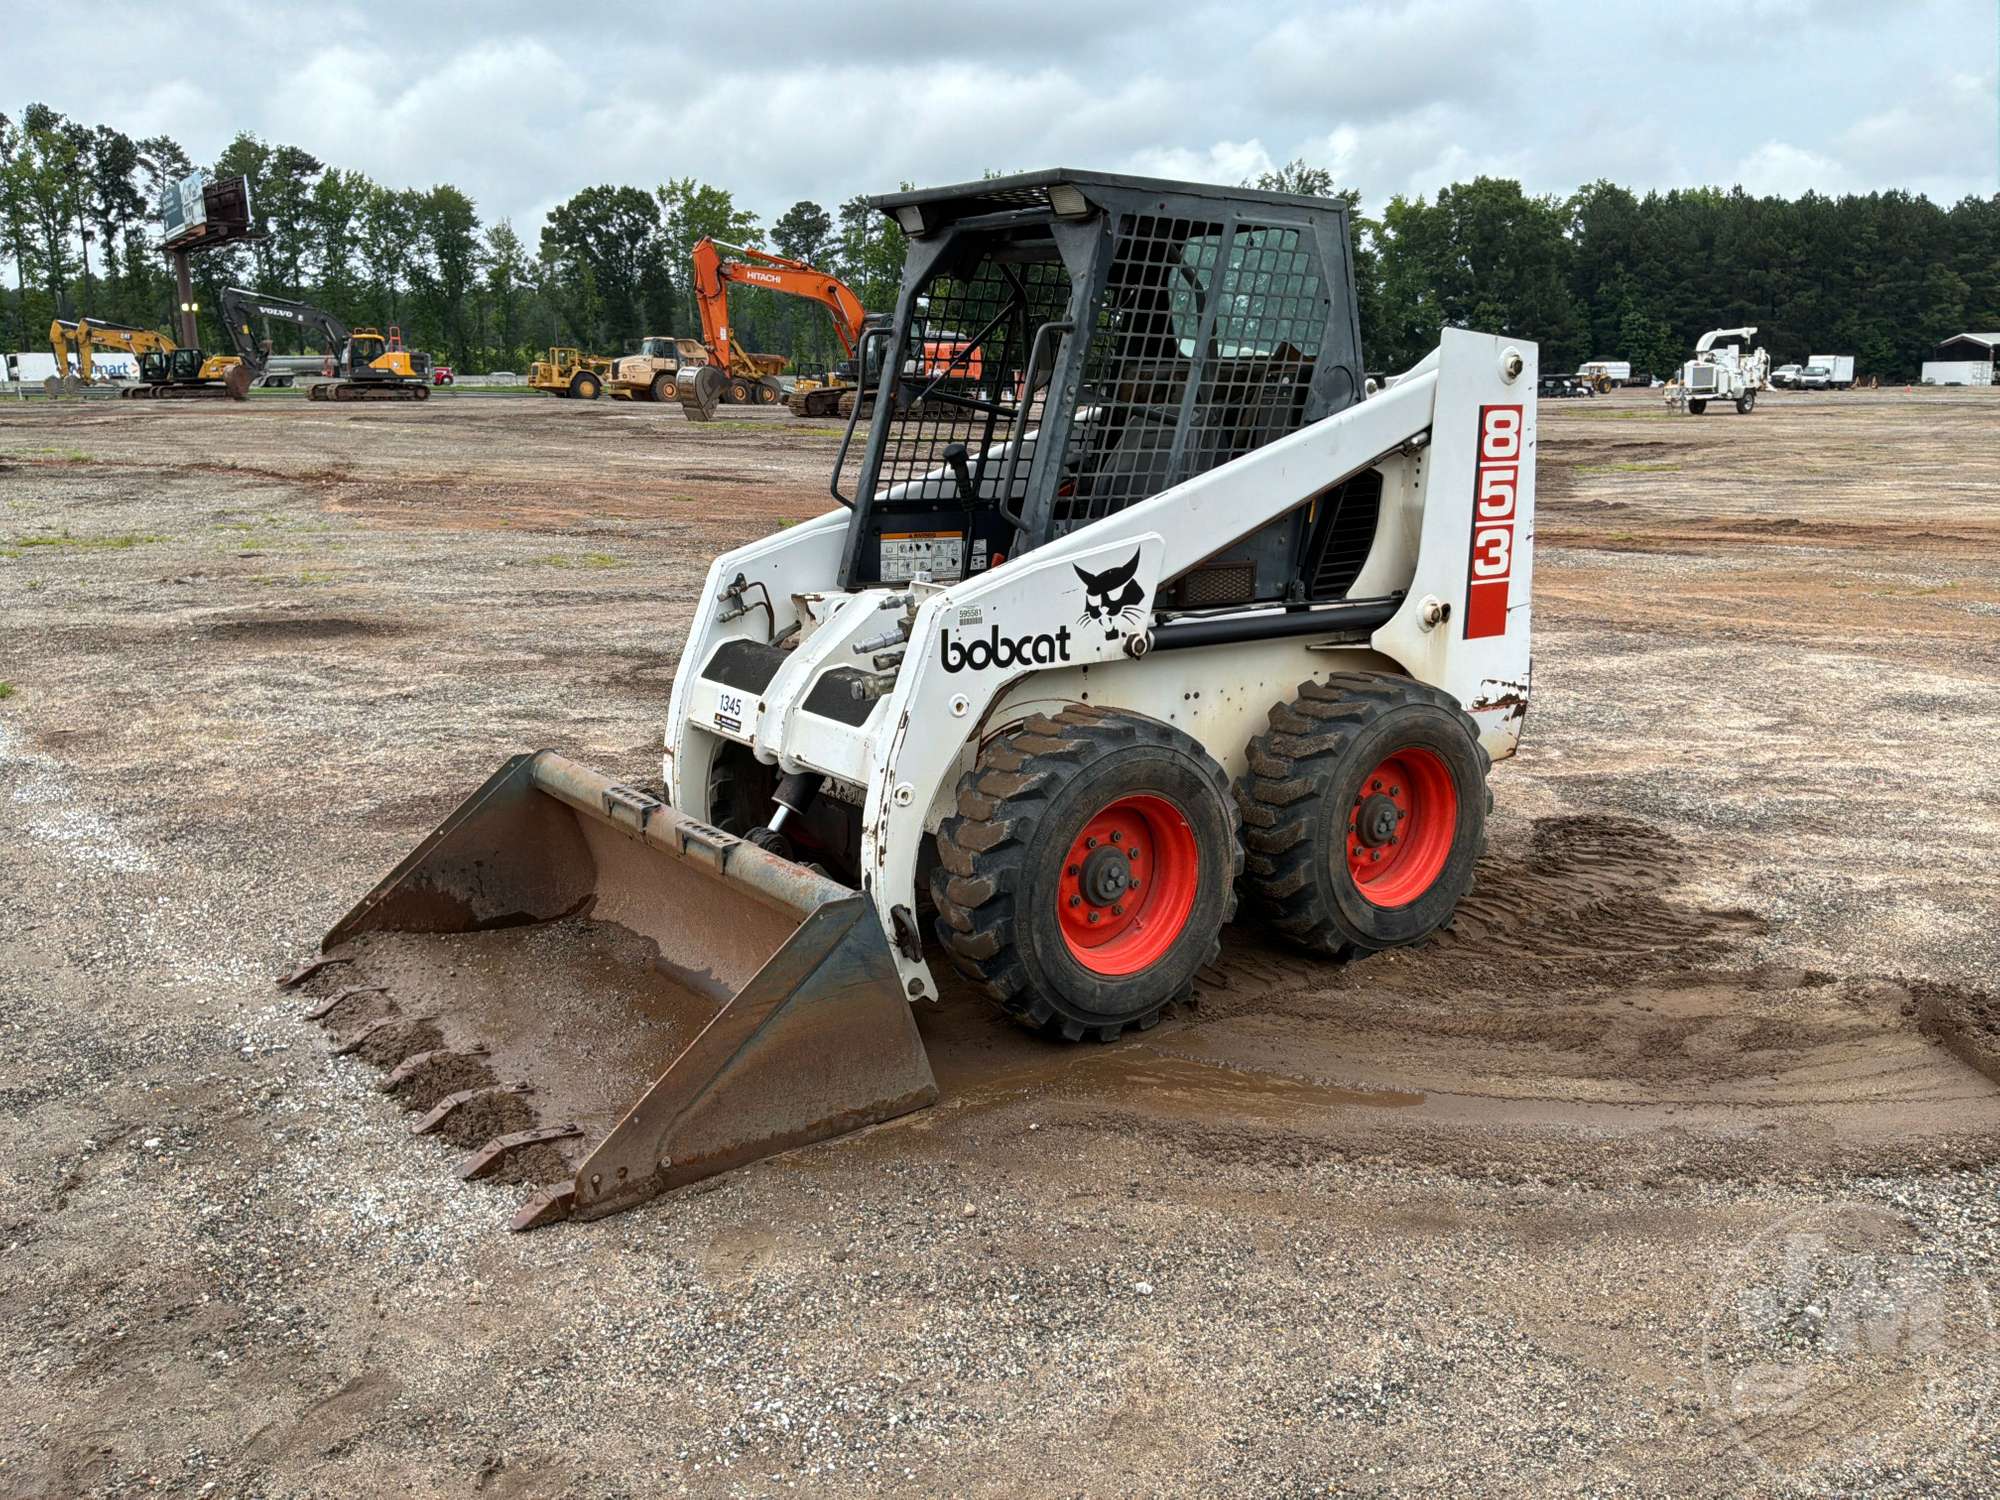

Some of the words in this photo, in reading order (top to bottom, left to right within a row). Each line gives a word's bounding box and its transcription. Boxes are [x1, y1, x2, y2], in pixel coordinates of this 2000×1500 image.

[747, 271, 781, 283] HITACHI
[259, 306, 293, 318] VOLVO
[1474, 409, 1520, 577] 853
[959, 608, 982, 618] 595581
[941, 624, 1071, 673] bobcat
[720, 694, 742, 716] 1345
